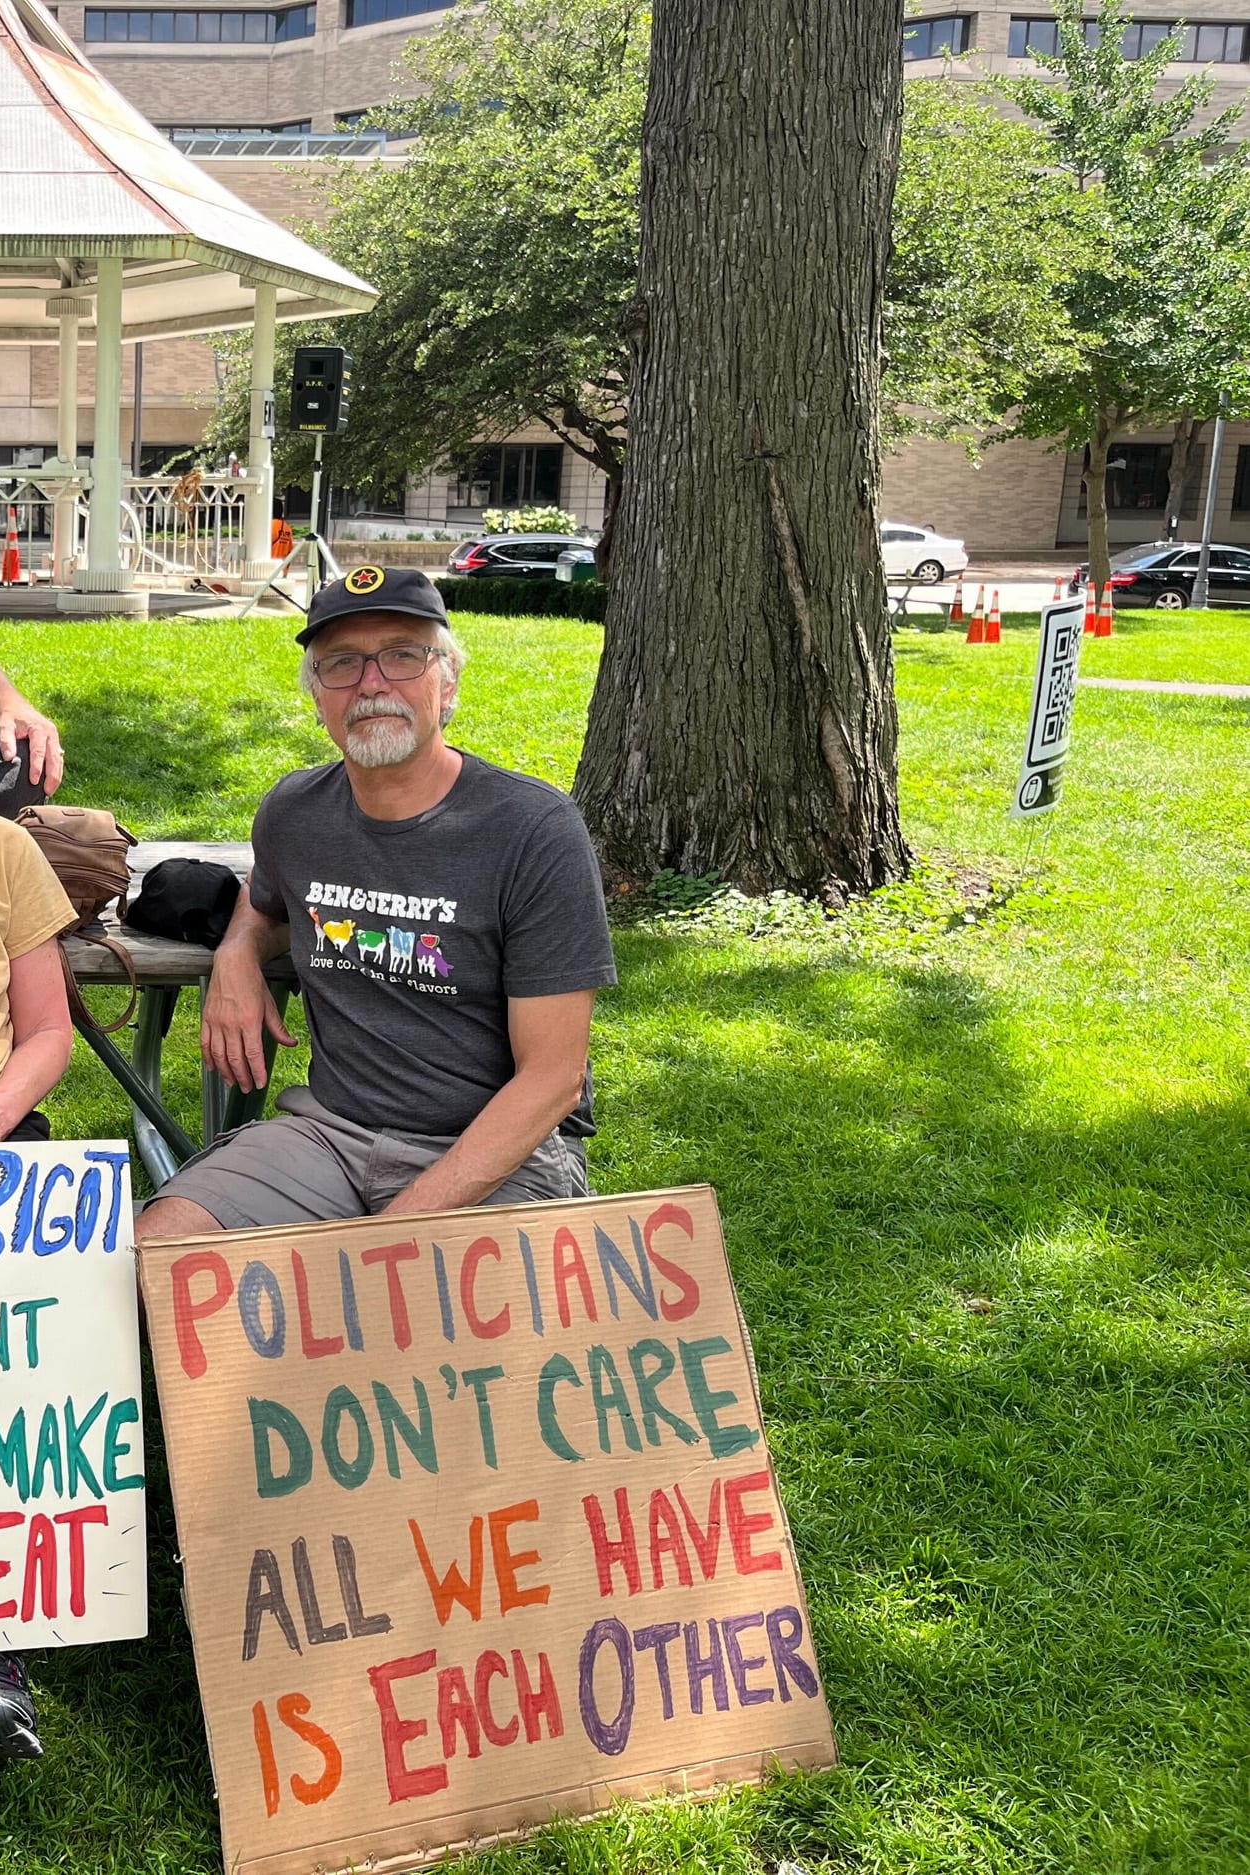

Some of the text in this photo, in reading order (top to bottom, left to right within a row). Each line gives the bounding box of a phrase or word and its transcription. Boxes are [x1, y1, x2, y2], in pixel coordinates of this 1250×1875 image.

[310, 955, 333, 968] love
[170, 1203, 700, 1379] POLITICIANS
[247, 1335, 760, 1499] DON'T CARE
[242, 1470, 783, 1661] ALL WE HAVE
[252, 1605, 819, 1819] IS EACH OTHER
